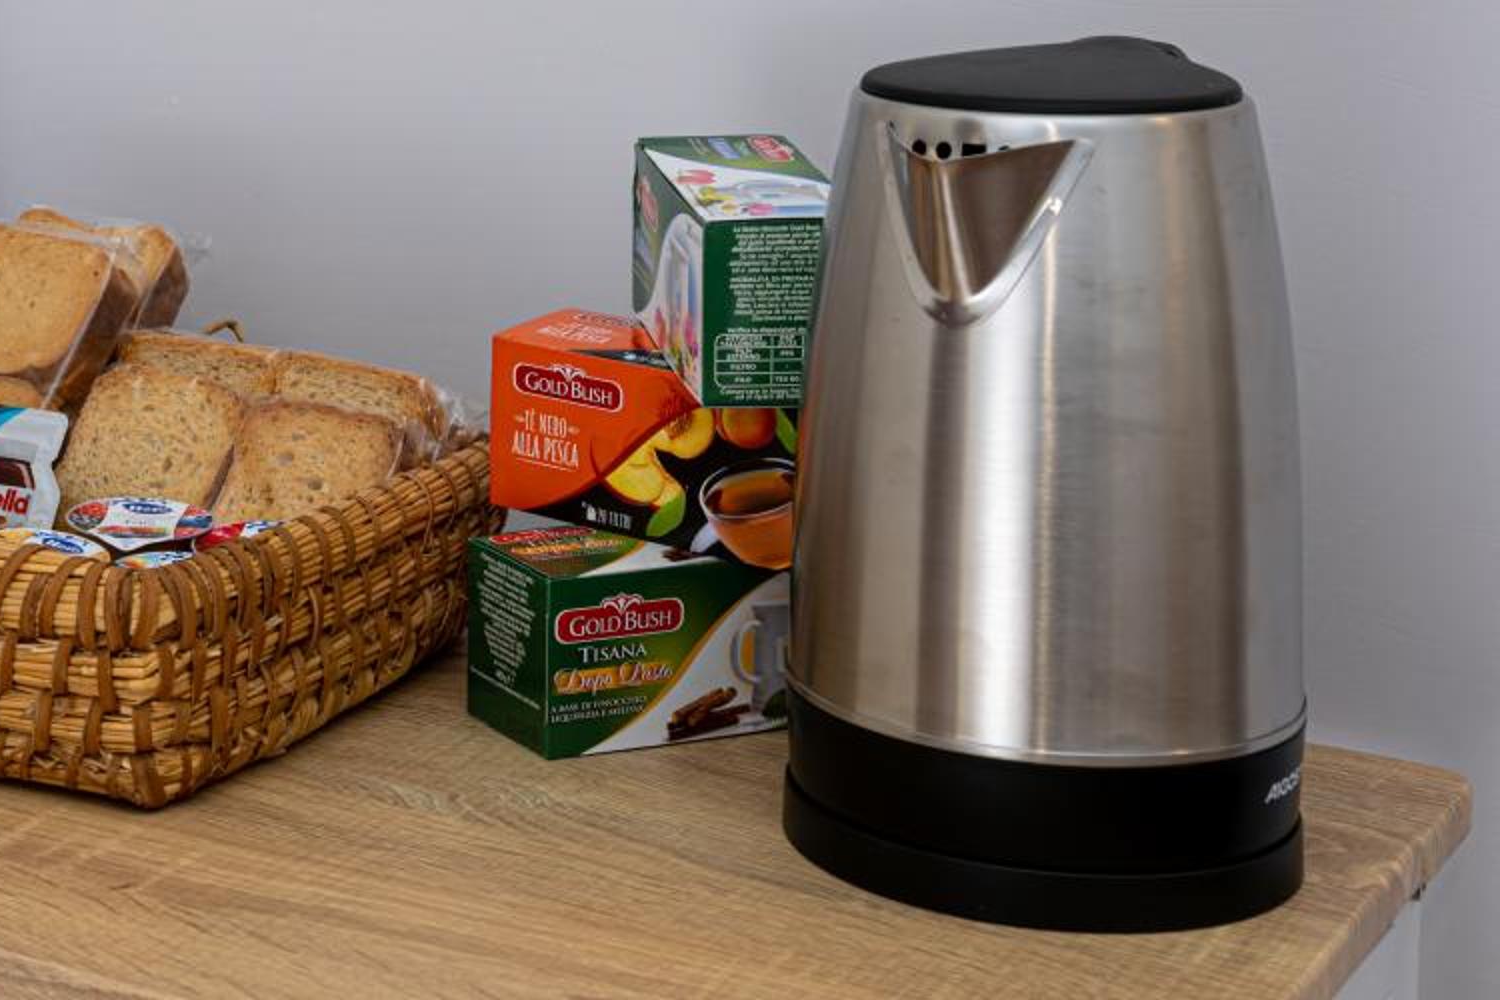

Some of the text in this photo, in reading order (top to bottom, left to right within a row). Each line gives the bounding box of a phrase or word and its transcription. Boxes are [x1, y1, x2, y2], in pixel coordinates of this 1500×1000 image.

[524, 371, 613, 406] GOLD BUSH
[543, 437, 579, 469] PESCA
[569, 609, 672, 637] GOLD BUSH
[578, 643, 647, 663] TISANA
